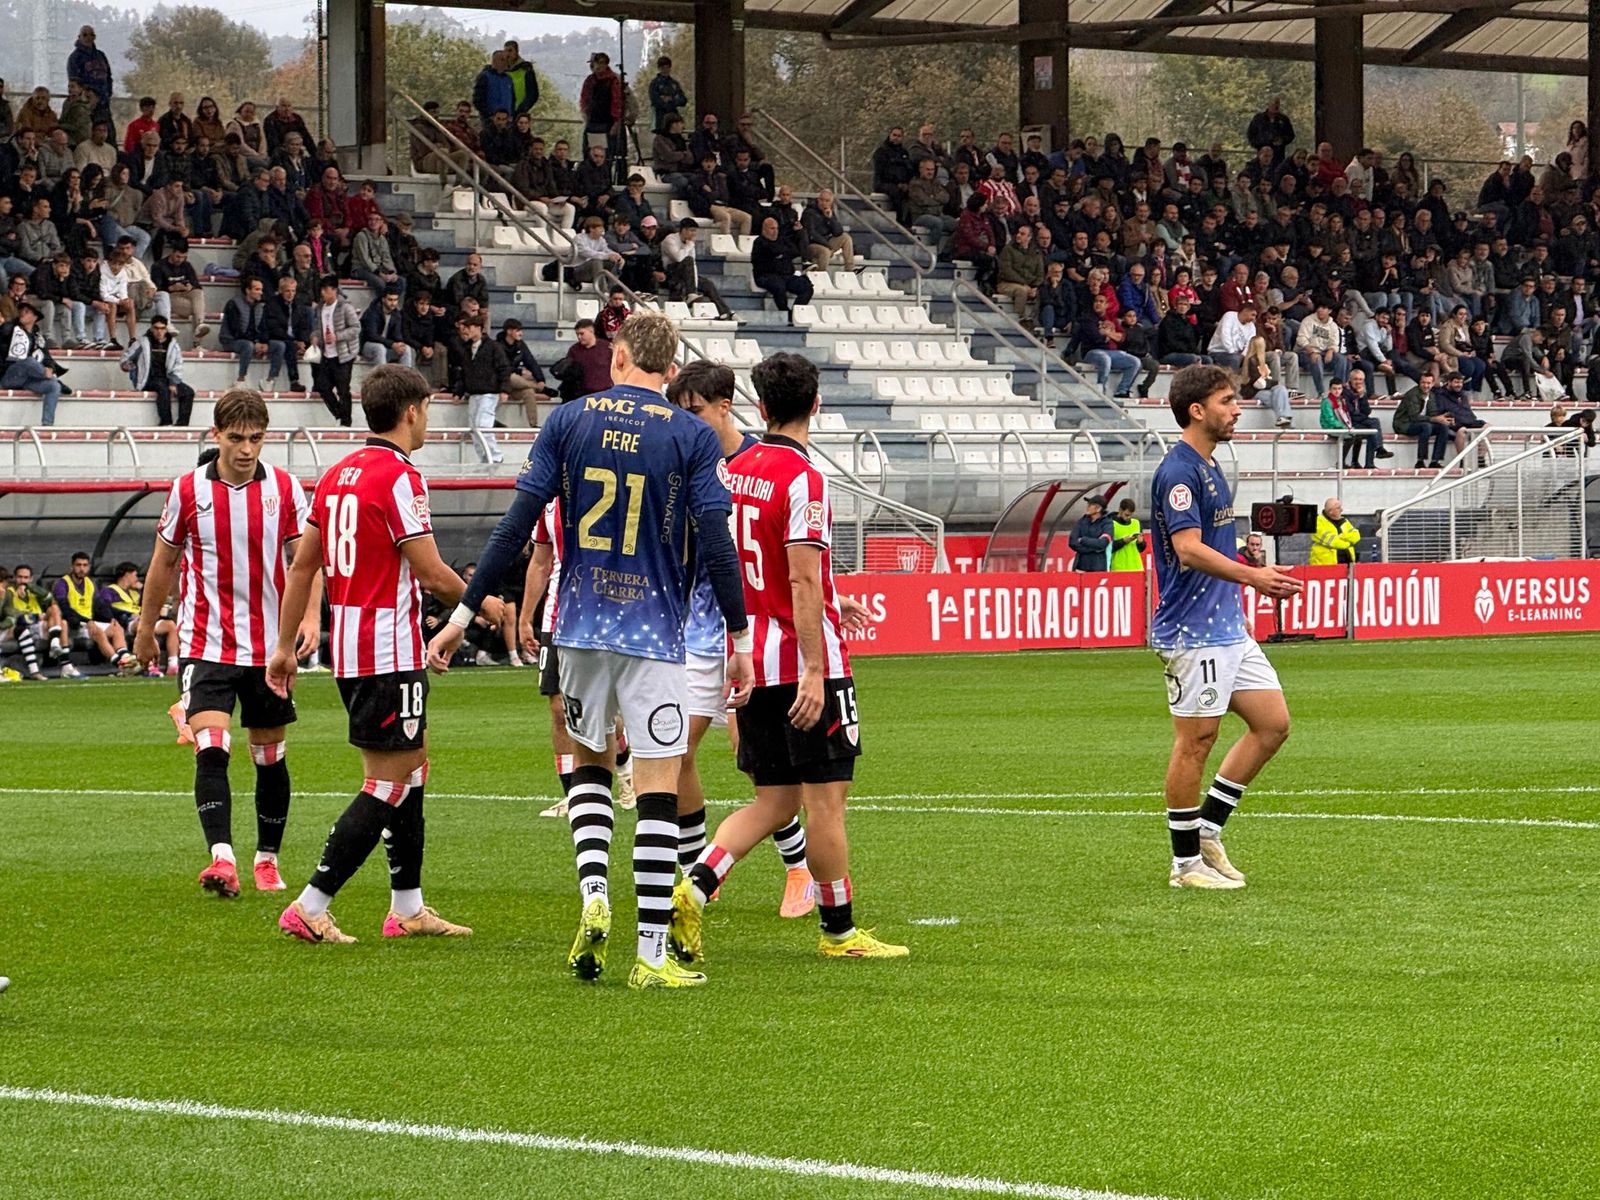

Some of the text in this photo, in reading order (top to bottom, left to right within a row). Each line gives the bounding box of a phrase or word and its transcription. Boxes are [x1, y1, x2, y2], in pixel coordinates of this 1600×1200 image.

[583, 397, 636, 415] MMG
[601, 429, 641, 454] PERE
[578, 466, 646, 556] 21
[325, 492, 358, 578] 18
[590, 566, 650, 587] TERNERA
[592, 580, 645, 600] CHARRA
[1495, 576, 1591, 606] VERSUS
[963, 578, 1132, 641] FEDERACIÓN
[1507, 607, 1582, 622] E-LEARNING
[1200, 658, 1216, 684] 11
[399, 681, 423, 718] 18
[836, 686, 858, 726] 15
